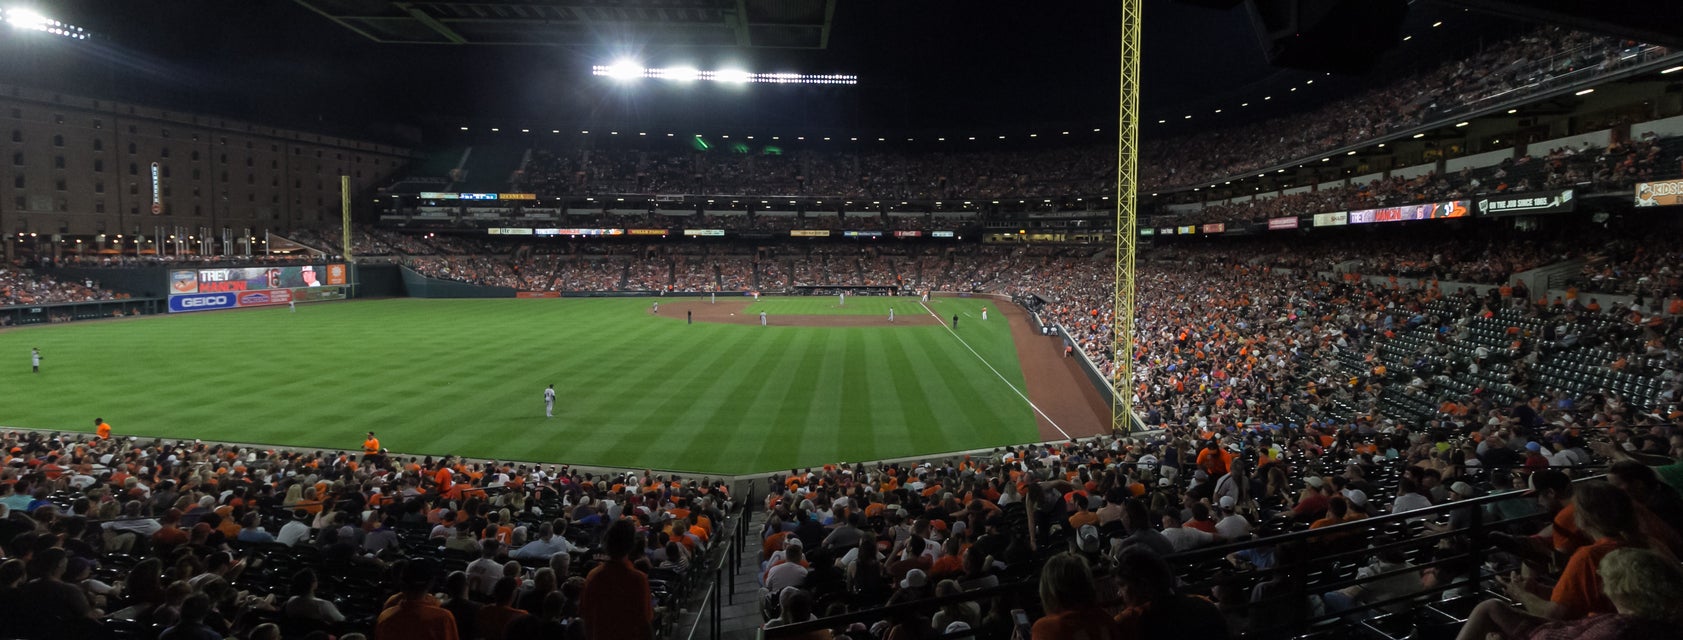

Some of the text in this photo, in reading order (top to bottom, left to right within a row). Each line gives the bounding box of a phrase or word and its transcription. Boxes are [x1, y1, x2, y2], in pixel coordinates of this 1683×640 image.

[1653, 182, 1677, 196] KIDS
[200, 269, 229, 282] TREY
[181, 296, 227, 307] GEICO
